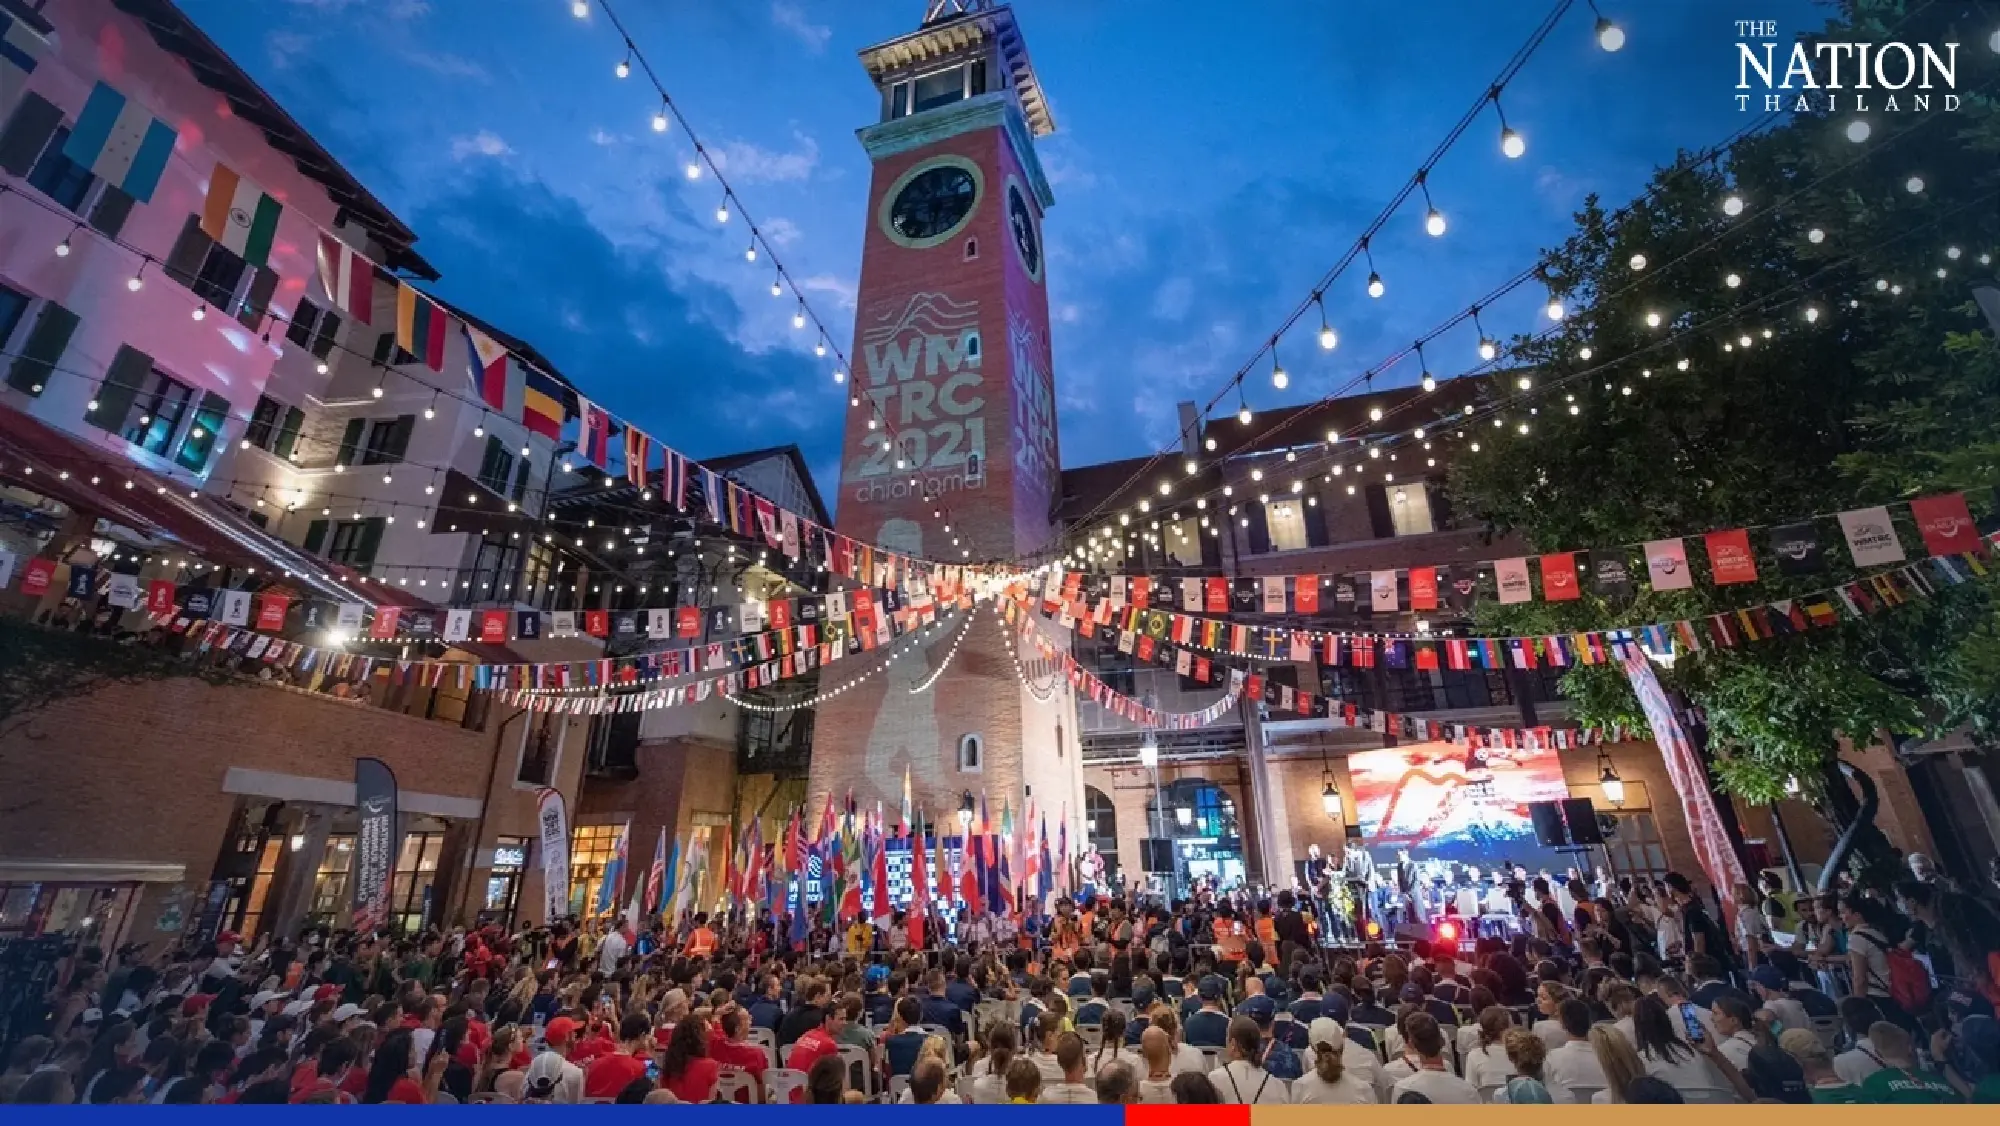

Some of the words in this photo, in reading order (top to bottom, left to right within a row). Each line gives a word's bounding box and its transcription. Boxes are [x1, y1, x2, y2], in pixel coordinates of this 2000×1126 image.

[863, 331, 981, 387] WM
[863, 372, 984, 427] TRC
[860, 417, 986, 477] 2021
